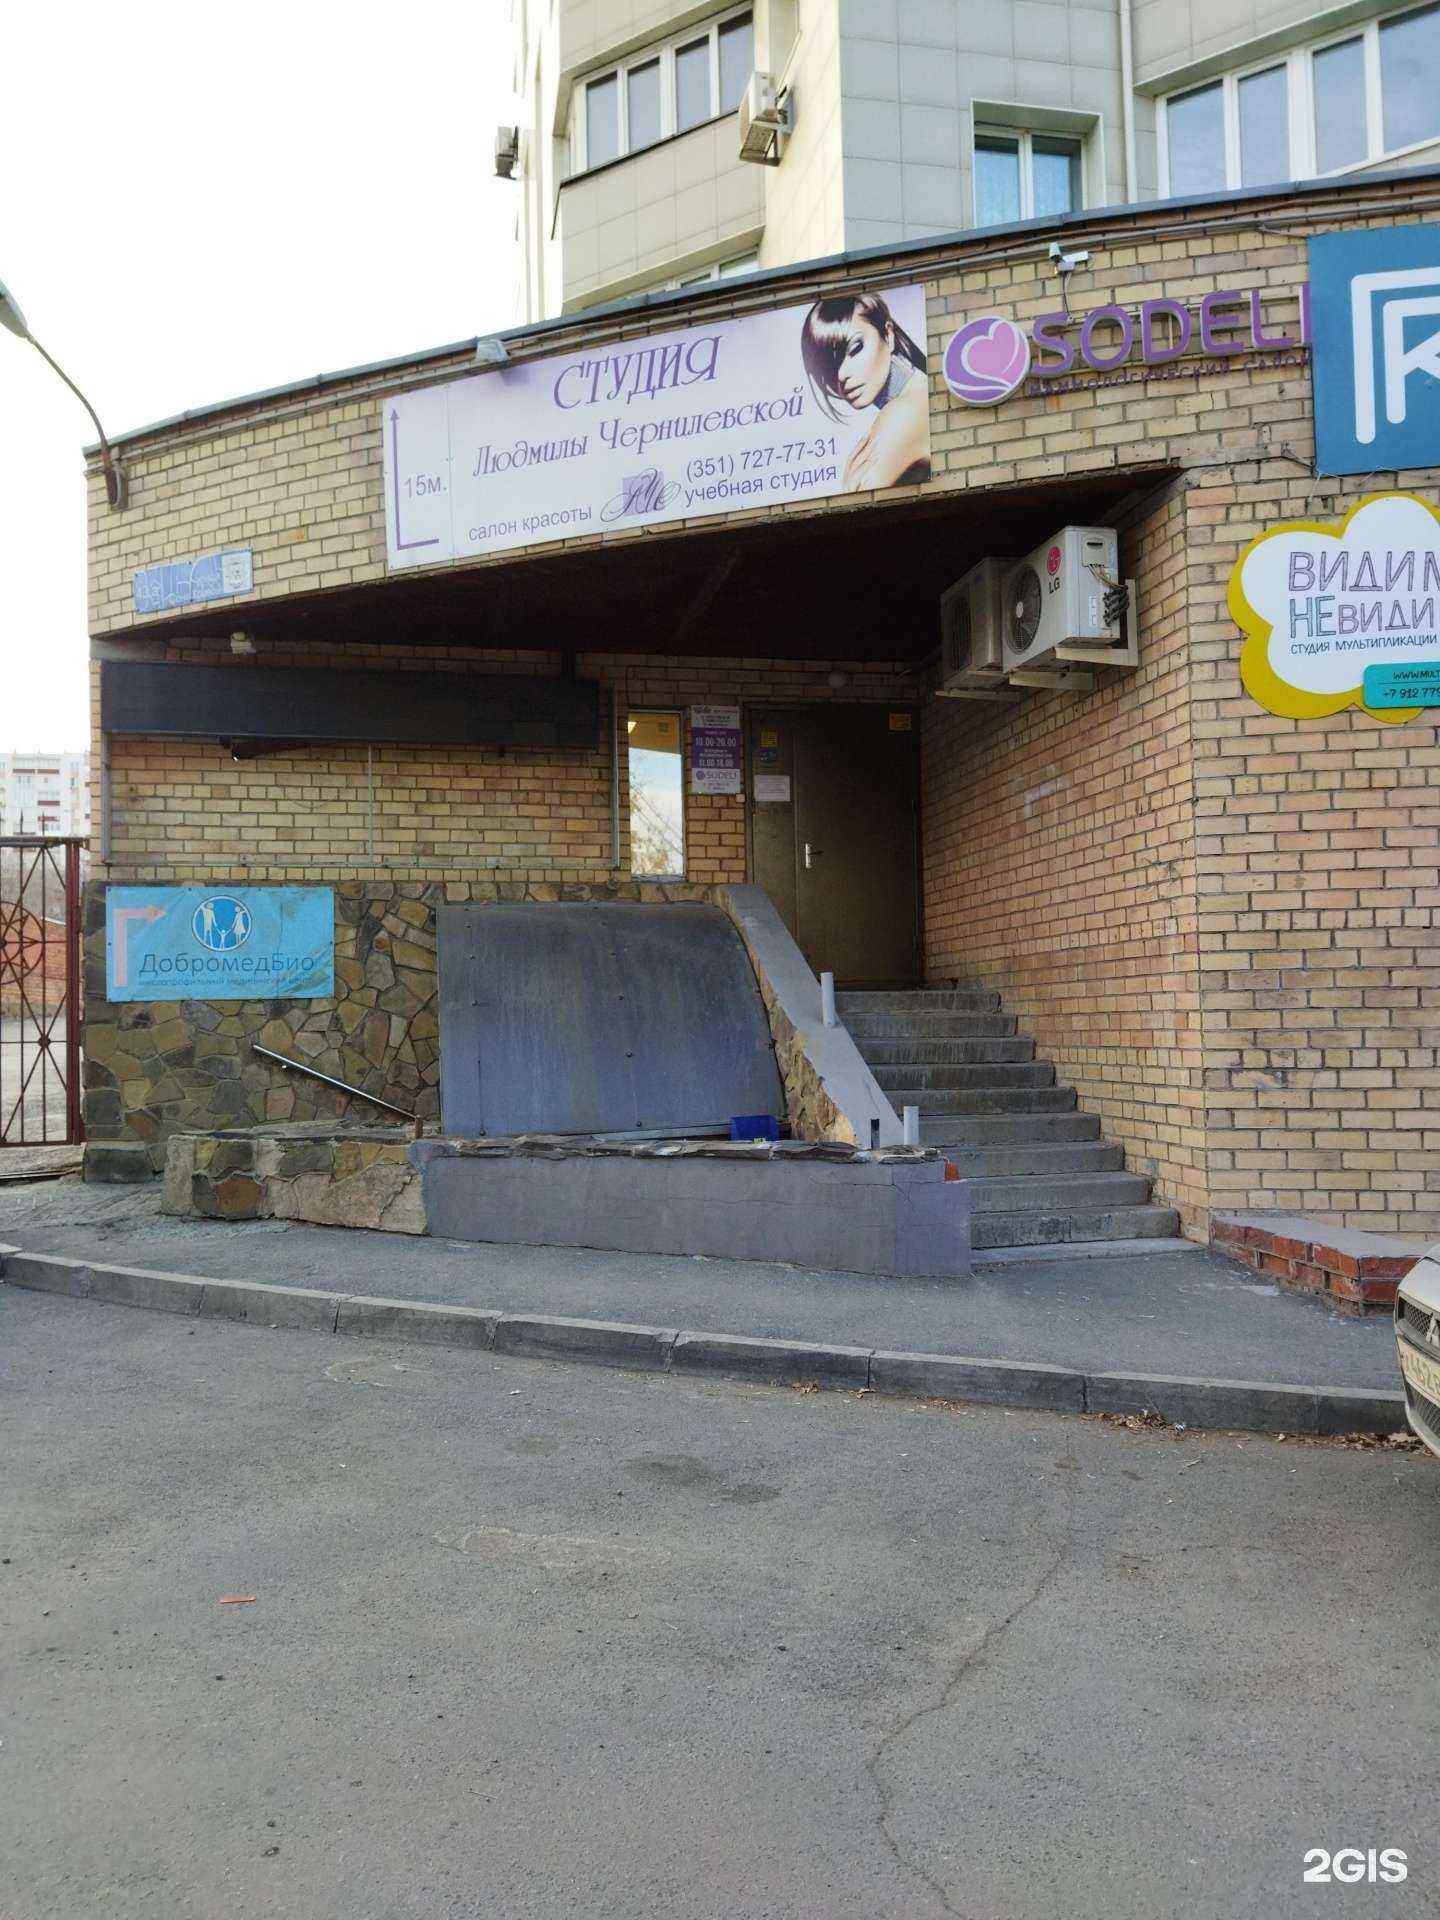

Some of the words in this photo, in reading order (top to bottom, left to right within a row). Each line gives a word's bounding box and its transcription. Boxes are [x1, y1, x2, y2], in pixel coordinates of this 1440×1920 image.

[553, 335, 722, 410] СТУДИЯ
[472, 436, 588, 477] Людмилы
[599, 385, 804, 454] Чернилевской
[686, 454, 735, 484] (351)
[740, 437, 838, 471] 727-77-31
[684, 477, 764, 508] учебная
[769, 465, 838, 491] студия
[468, 519, 518, 542] салон
[522, 506, 593, 536] красоты
[1048, 577, 1061, 594] LG
[1290, 642, 1331, 656] СТУДИЯ
[1335, 634, 1438, 652] МУЛЬТИПЛИКАЦИИ
[138, 951, 315, 978] ДобромедБио
